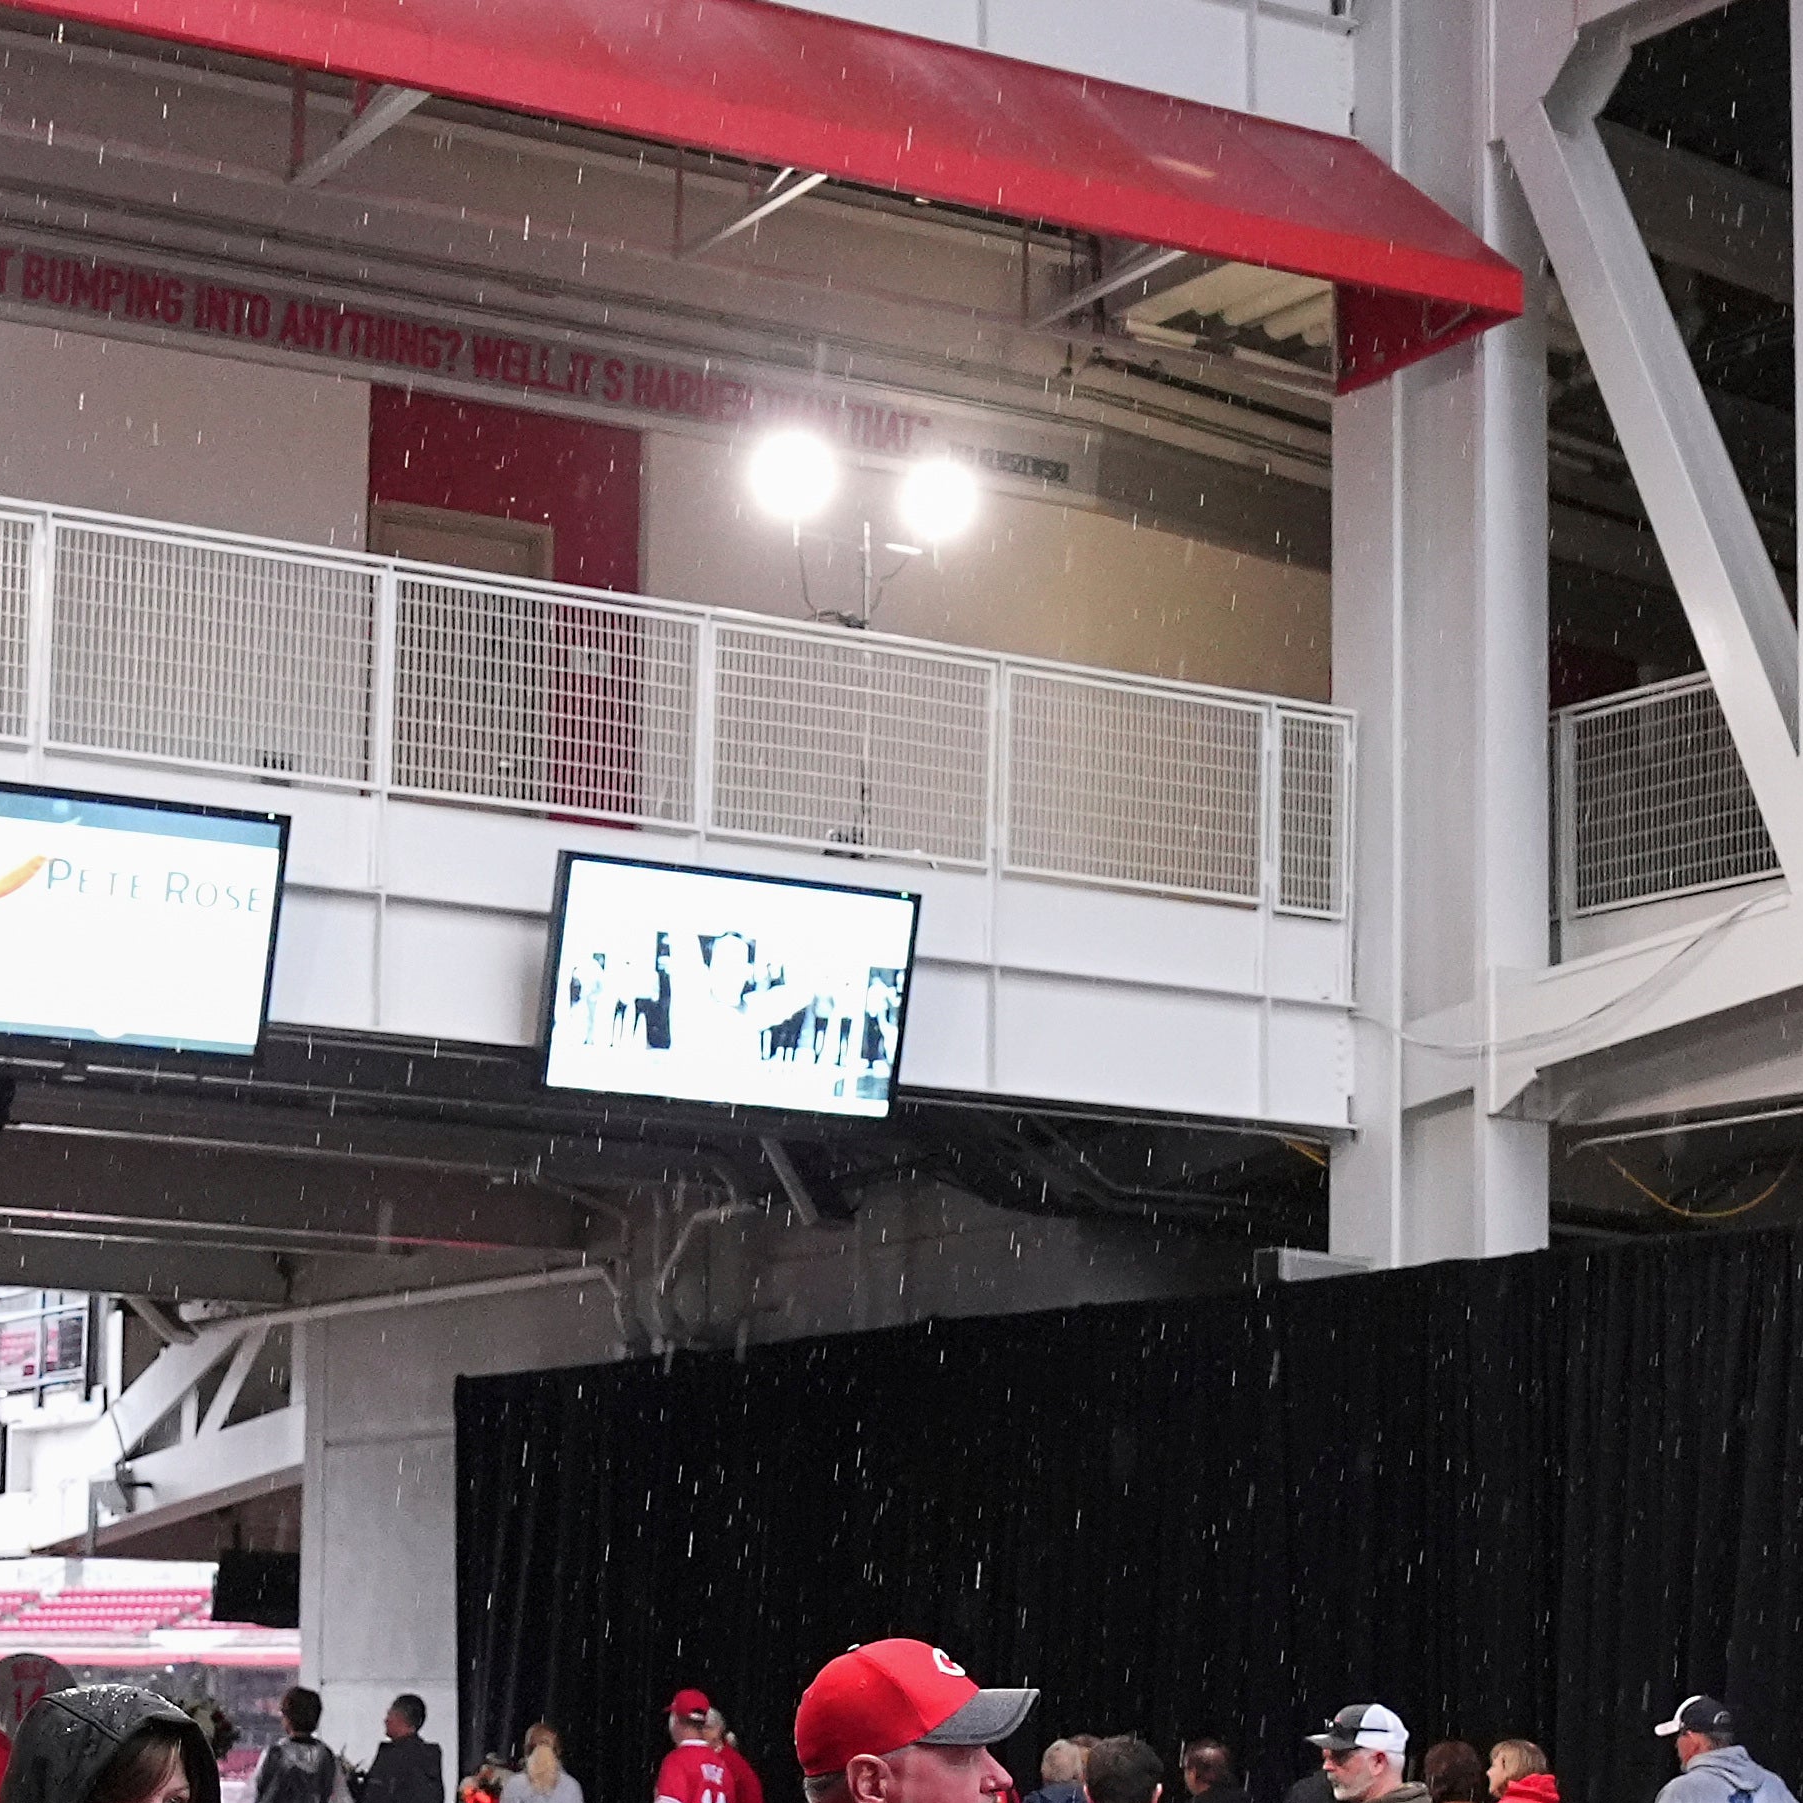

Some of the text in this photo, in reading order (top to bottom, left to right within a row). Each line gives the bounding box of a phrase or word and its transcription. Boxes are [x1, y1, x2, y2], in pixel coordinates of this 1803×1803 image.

[22, 251, 184, 325] BUMPING
[194, 282, 272, 339] INTO
[280, 298, 464, 373] ANYTHING?
[47, 858, 261, 912] PETE ROSE
